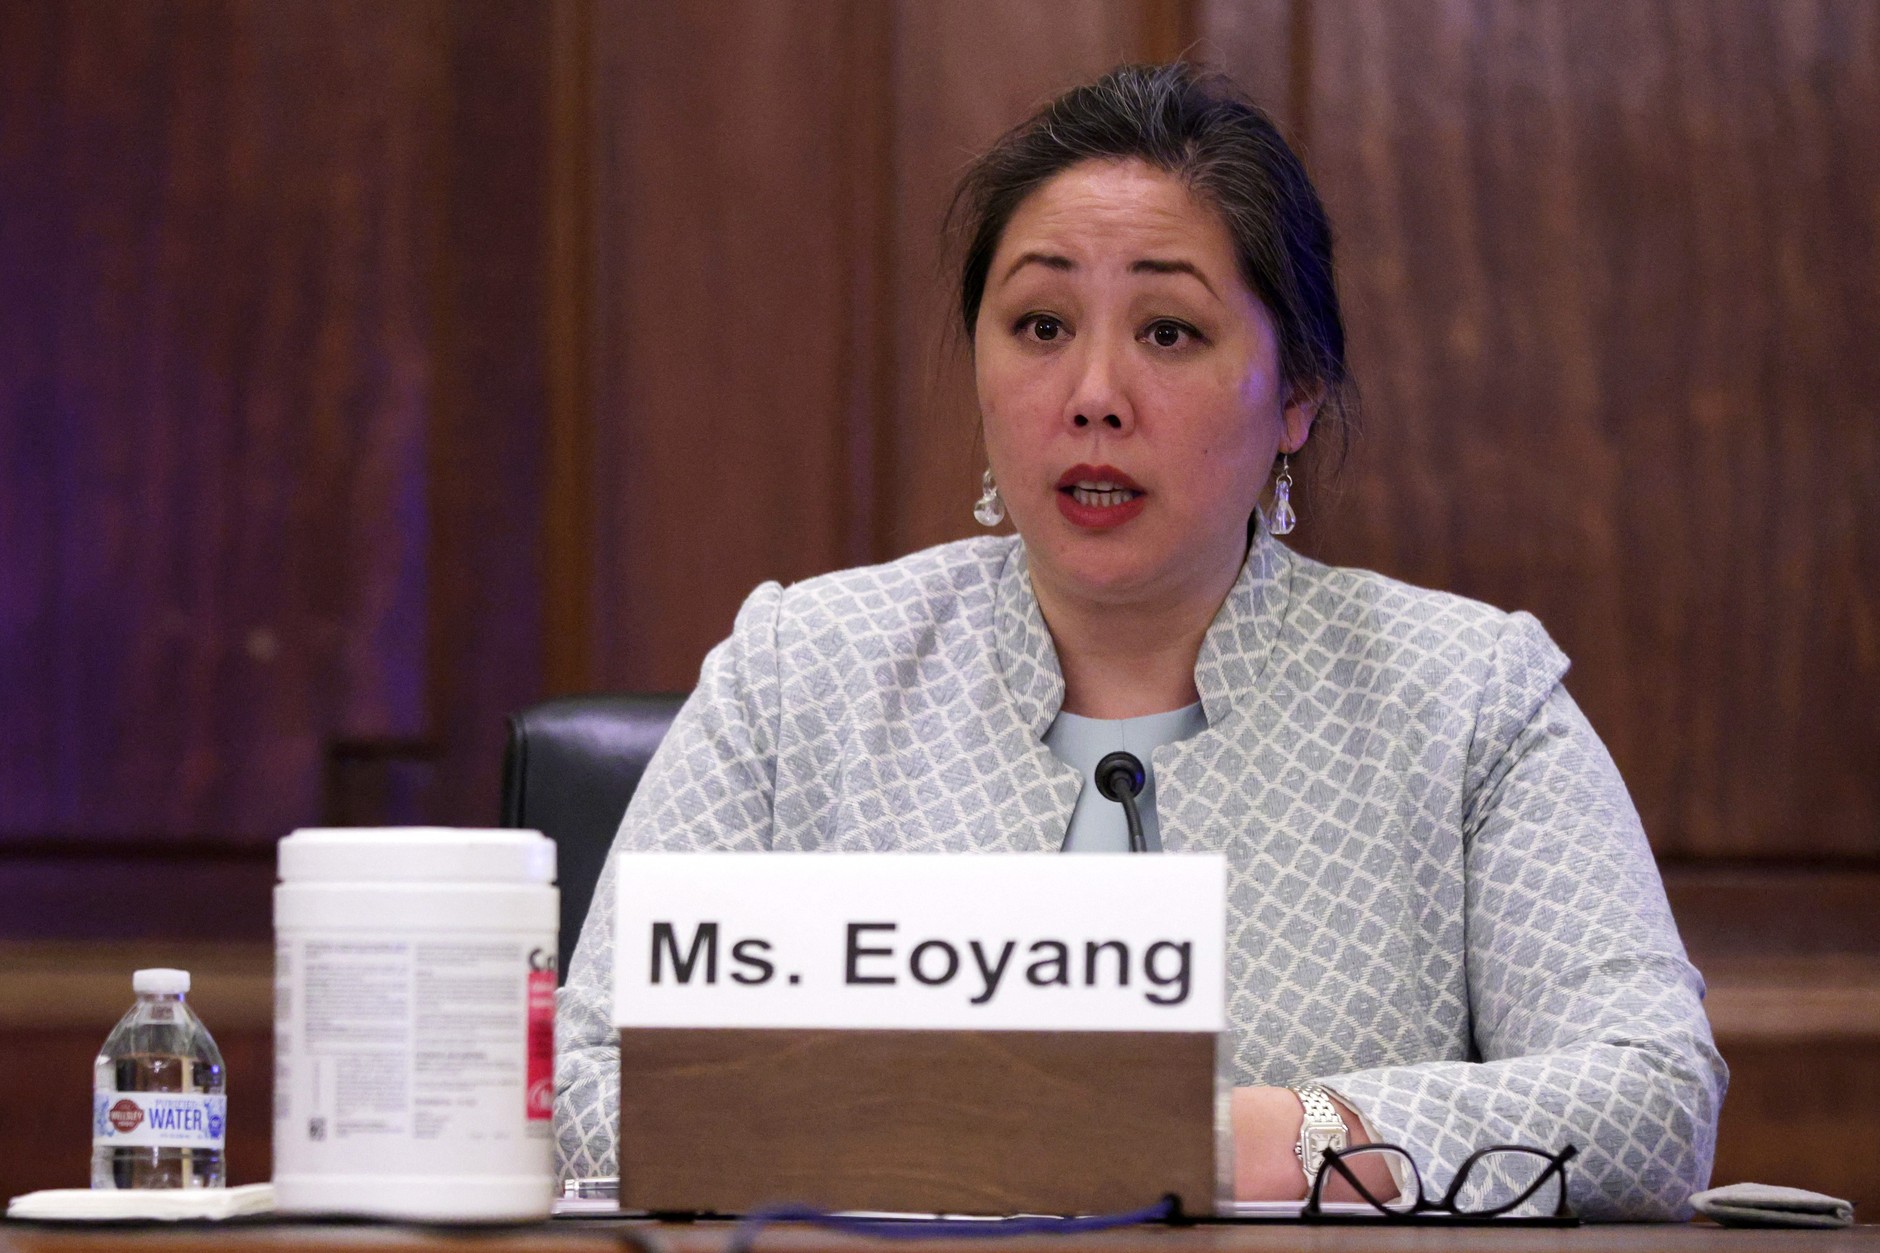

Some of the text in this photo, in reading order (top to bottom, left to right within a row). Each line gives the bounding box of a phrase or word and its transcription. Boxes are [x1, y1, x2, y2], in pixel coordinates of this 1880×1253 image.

[650, 922, 1191, 1006] Ms. Eoyang
[149, 1108, 202, 1130] WATER
